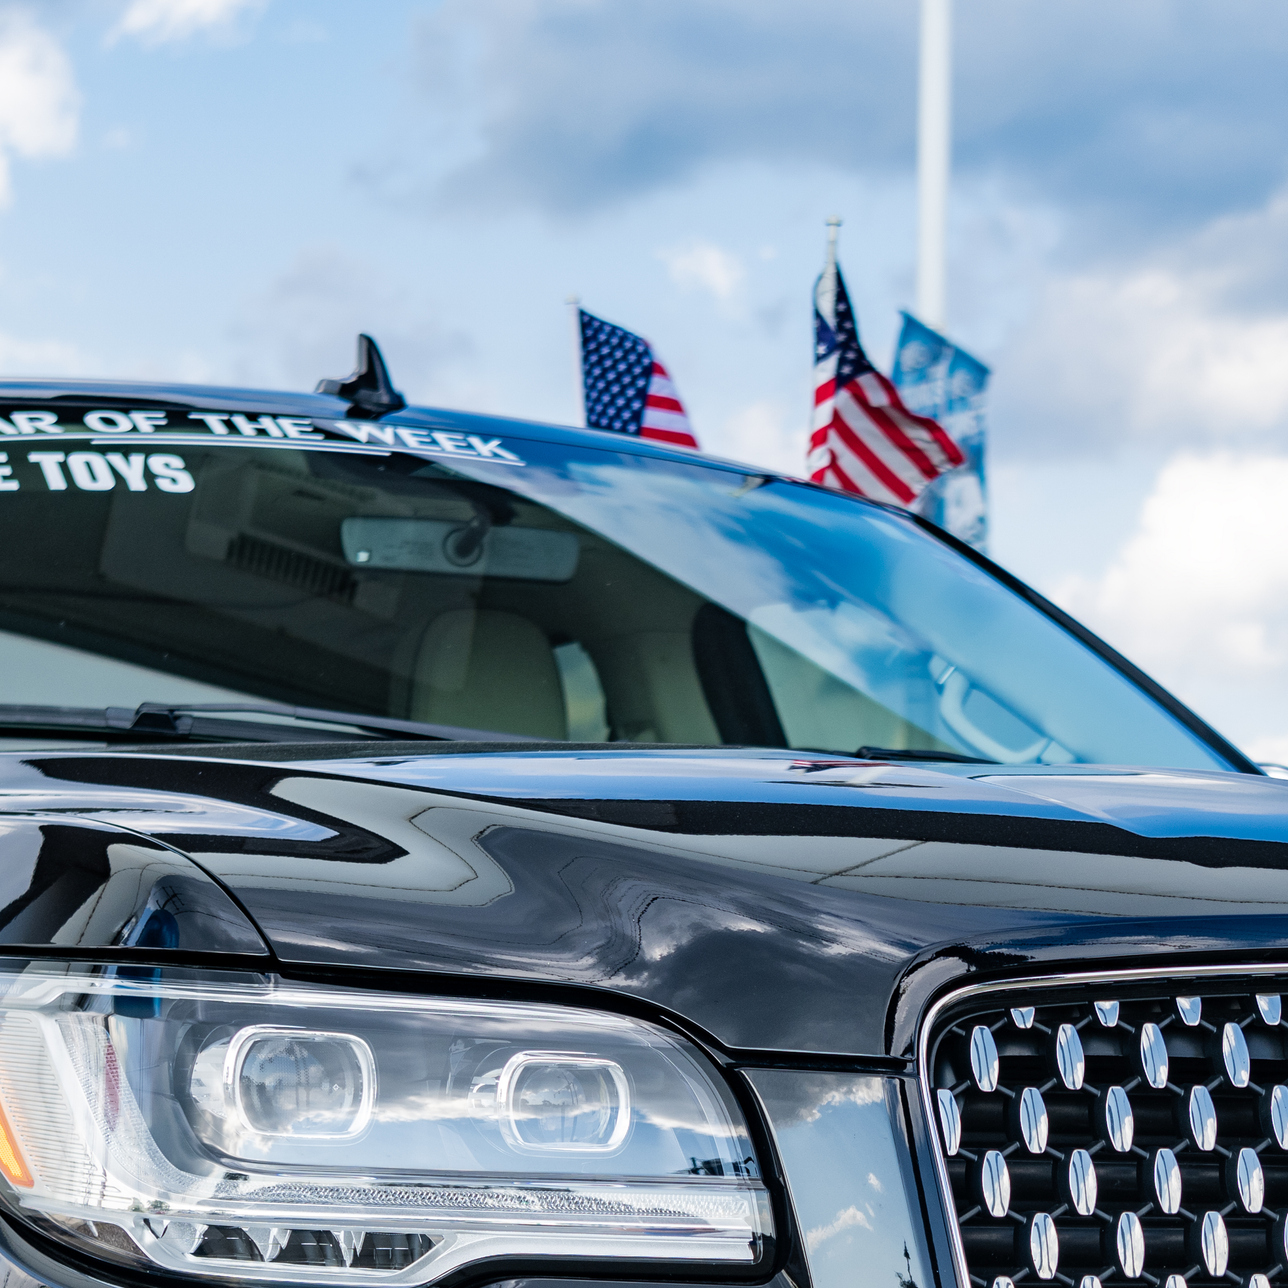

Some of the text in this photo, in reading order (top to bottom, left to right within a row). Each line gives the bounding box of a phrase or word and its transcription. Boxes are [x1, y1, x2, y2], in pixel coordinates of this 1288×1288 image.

[83, 409, 168, 433] OF
[187, 411, 325, 441] THE
[334, 421, 520, 461] WEEK
[27, 451, 196, 493] TOYS
